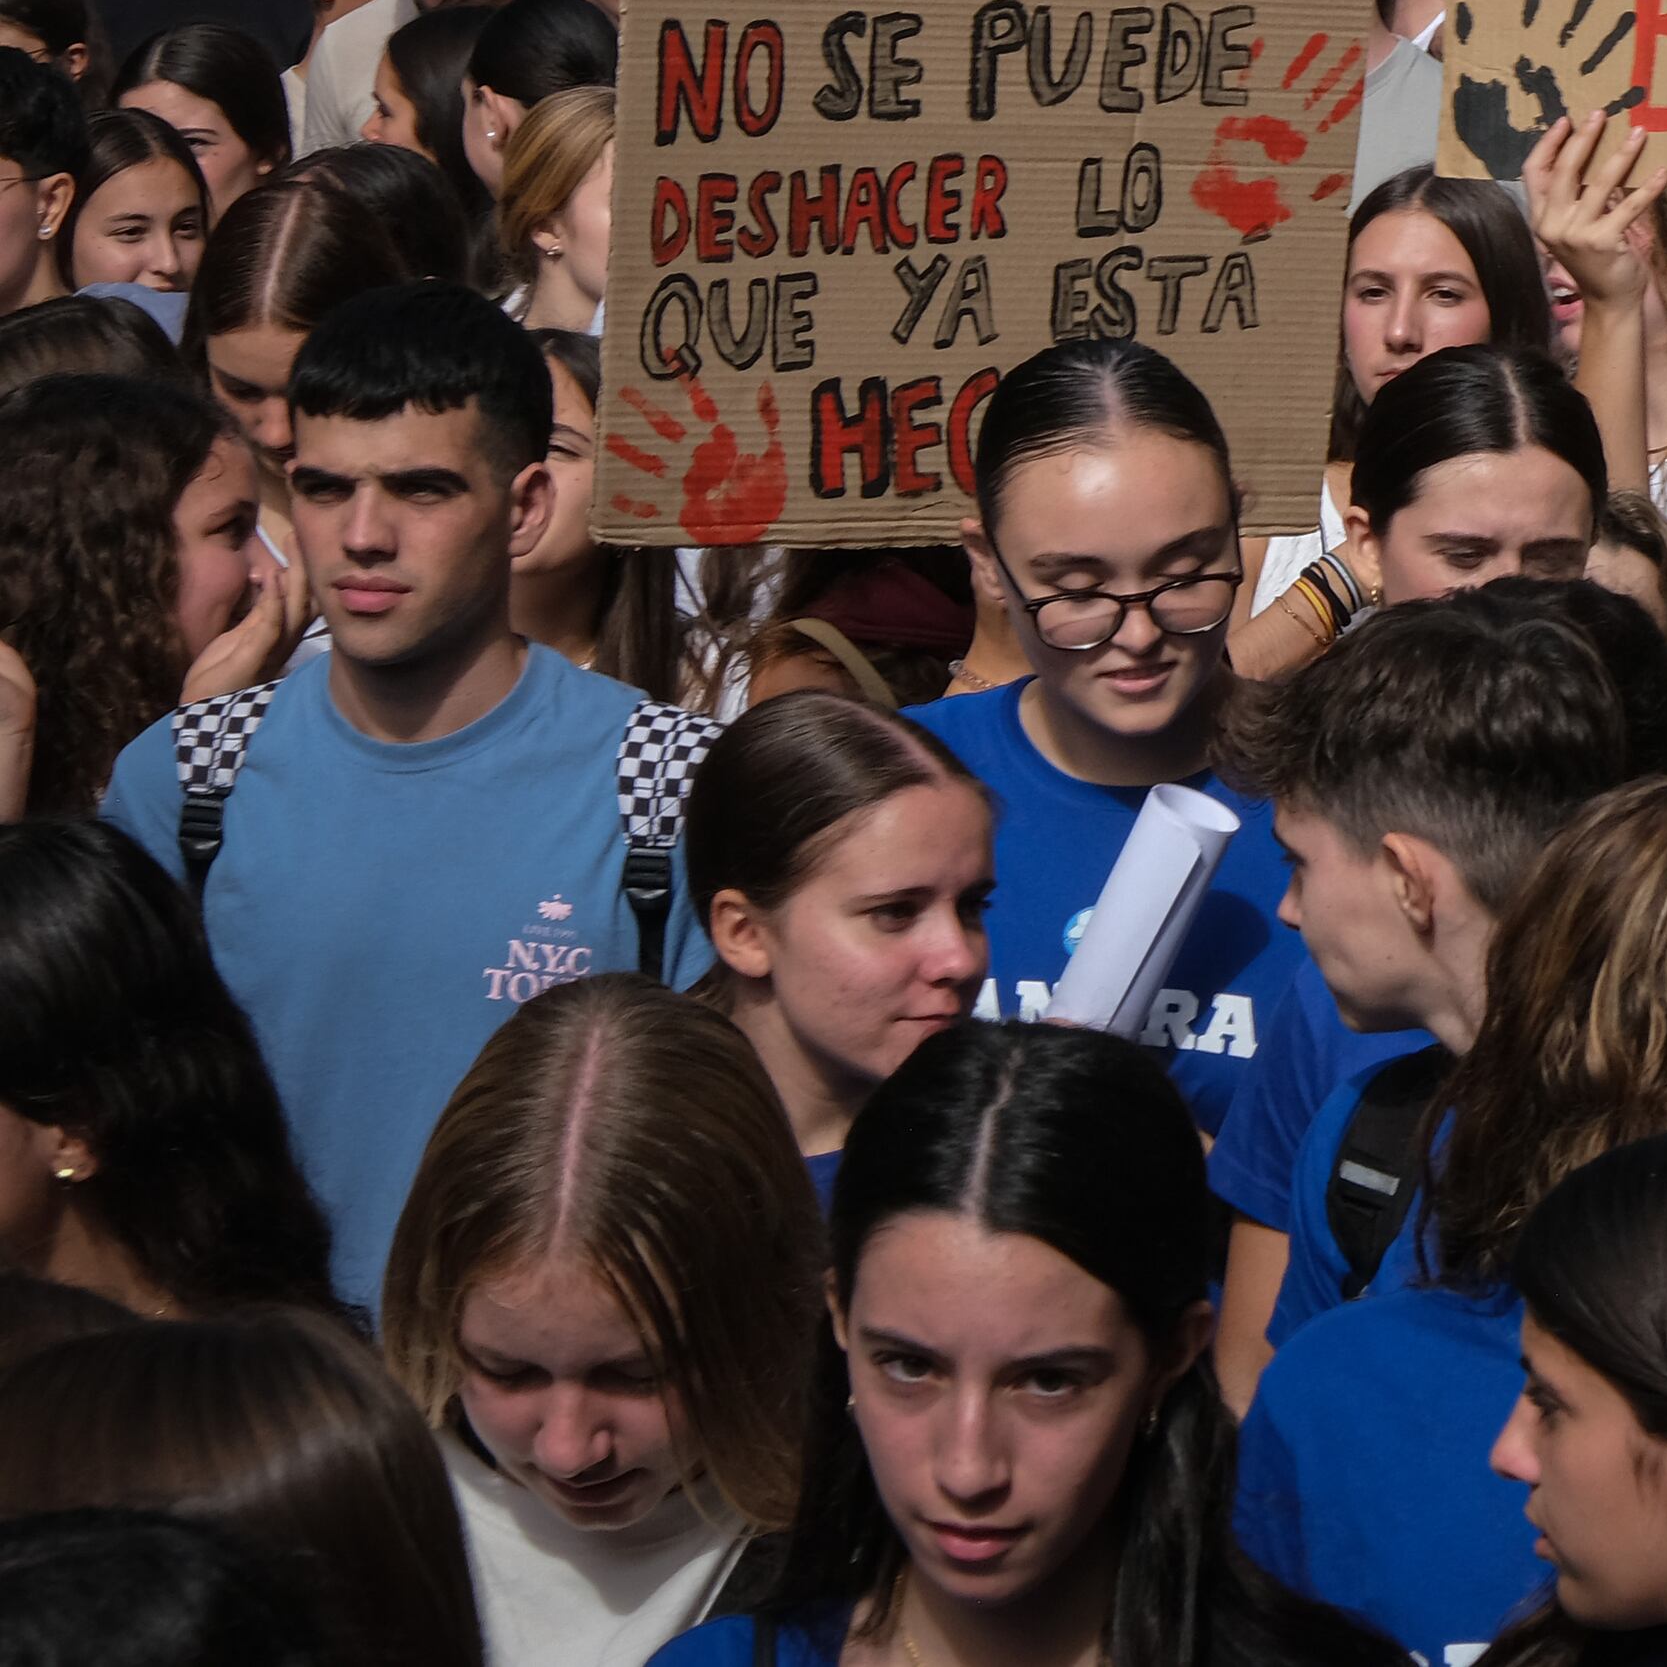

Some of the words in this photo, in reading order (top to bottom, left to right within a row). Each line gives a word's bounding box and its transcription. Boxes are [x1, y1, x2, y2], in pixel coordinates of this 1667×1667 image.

[655, 17, 785, 147] NO
[812, 11, 925, 122] SE
[649, 153, 1008, 268] DESHACER
[1075, 141, 1164, 239] LO
[638, 271, 819, 382] QUE
[892, 253, 999, 350] YA
[809, 365, 999, 500] HEC
